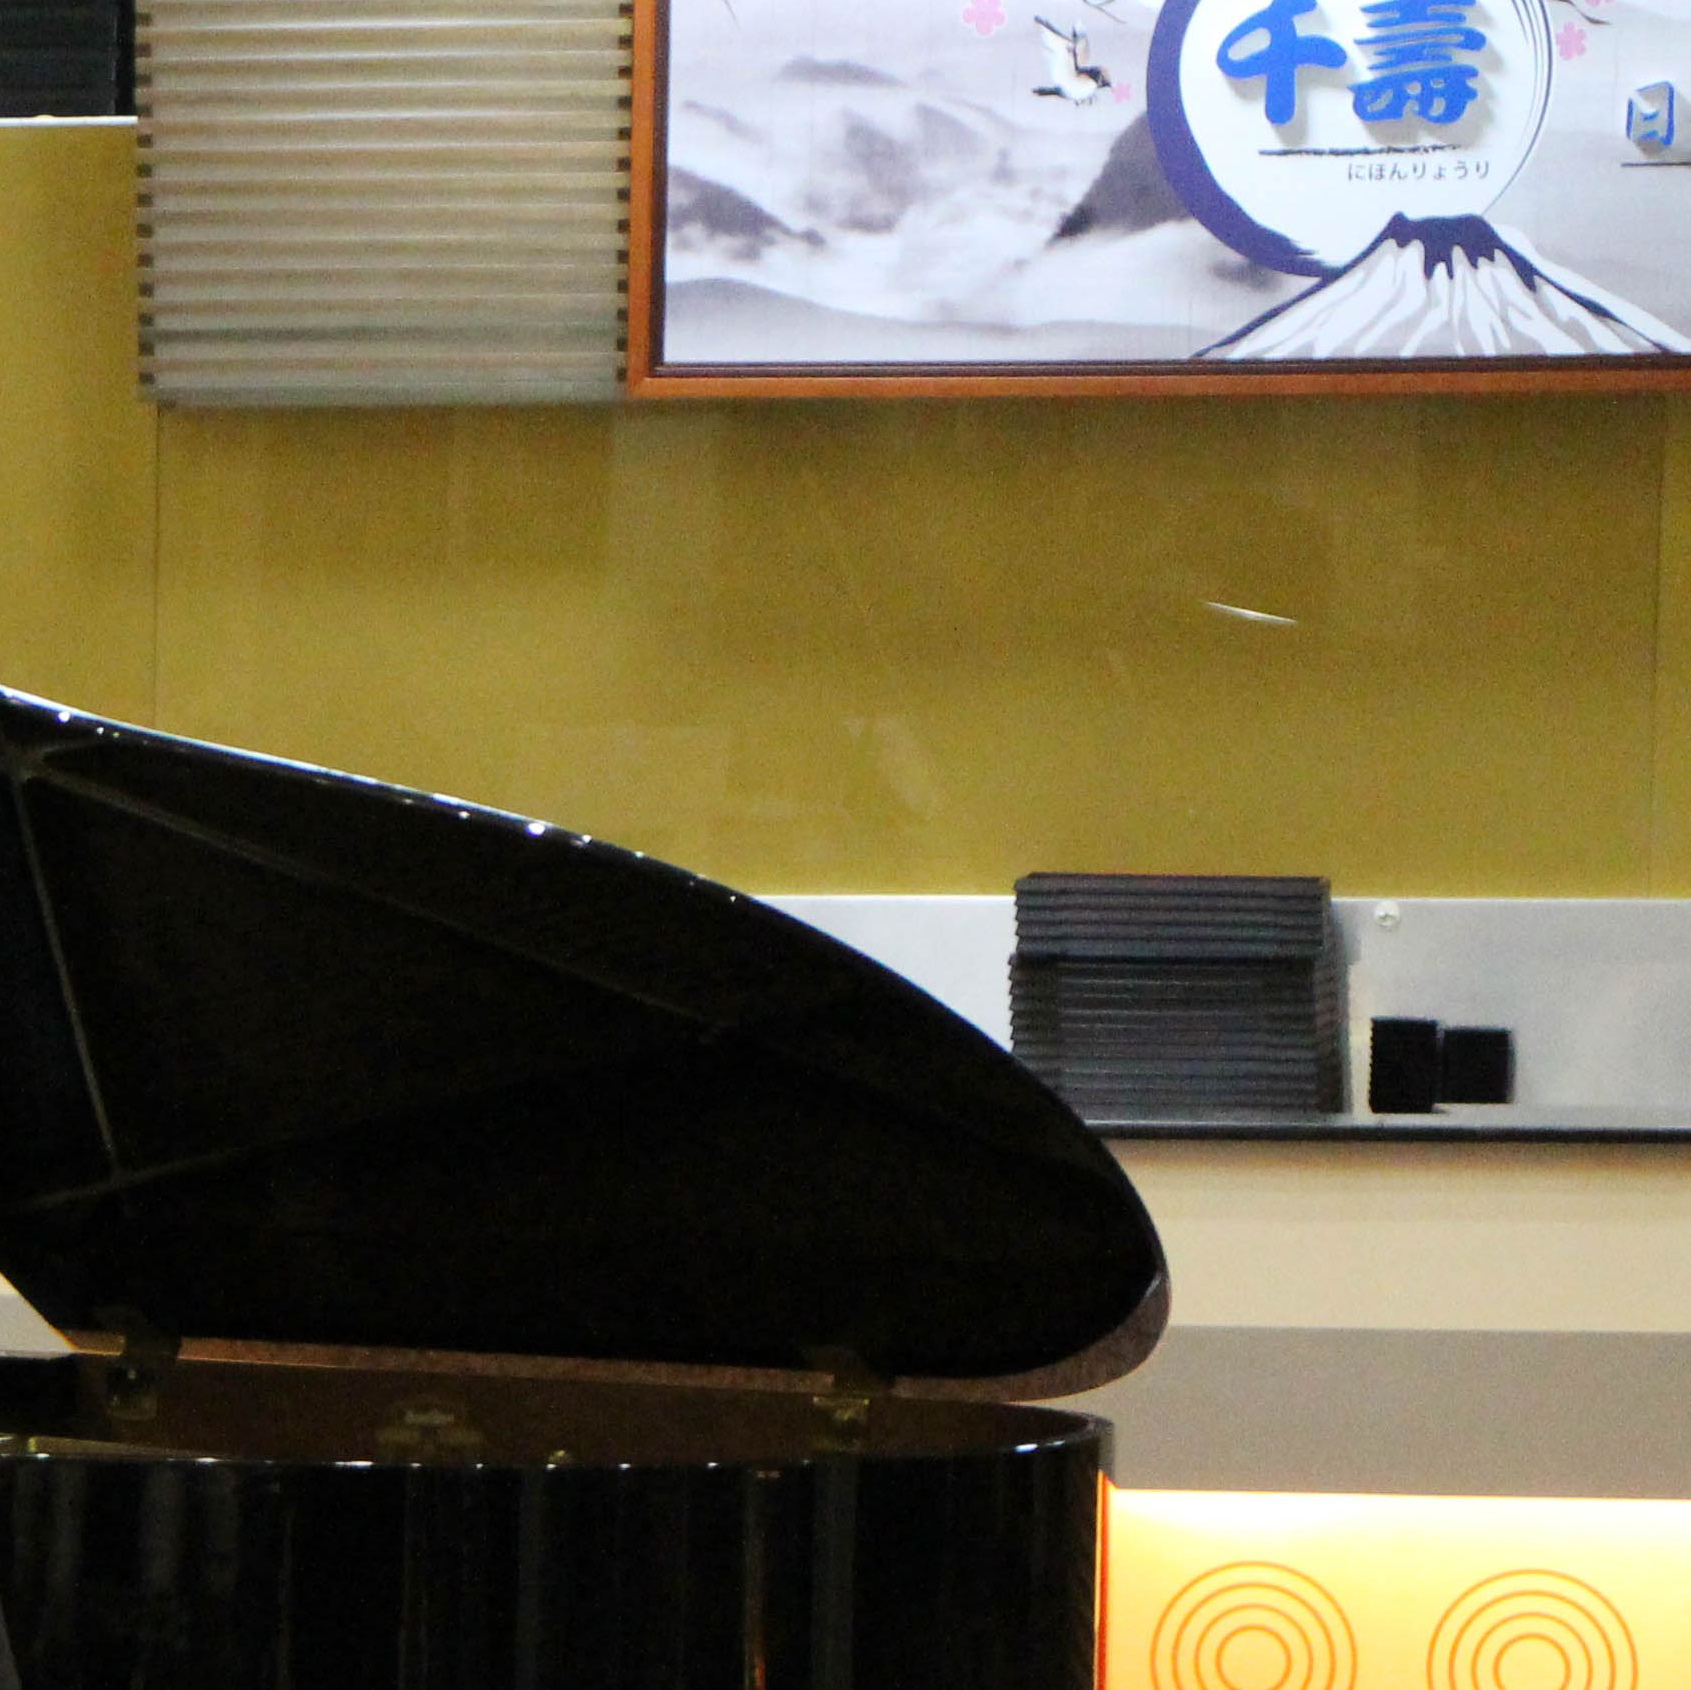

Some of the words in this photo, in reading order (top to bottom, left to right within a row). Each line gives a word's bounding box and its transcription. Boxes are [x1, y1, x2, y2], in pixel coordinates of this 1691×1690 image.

[1217, 0, 1486, 125] 千壽
[1347, 160, 1491, 181] にほんりょうり
